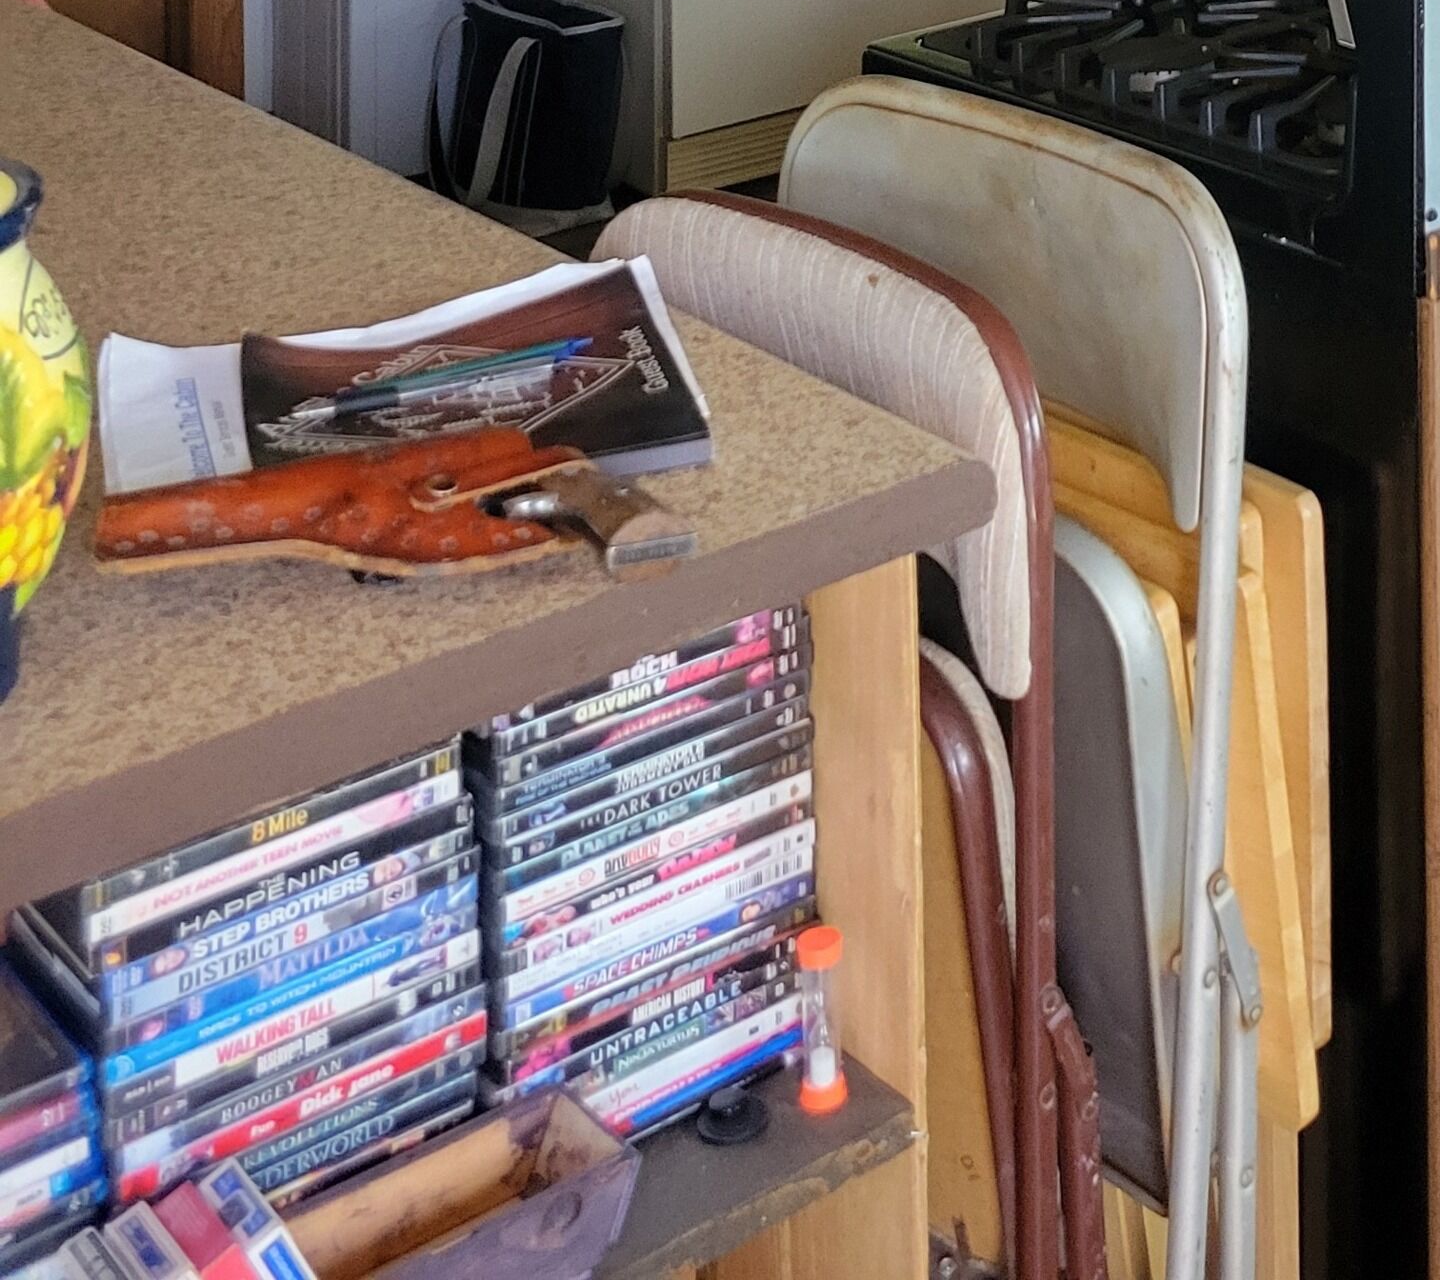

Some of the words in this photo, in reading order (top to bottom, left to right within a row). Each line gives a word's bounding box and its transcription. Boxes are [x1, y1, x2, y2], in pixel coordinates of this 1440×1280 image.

[618, 325, 652, 360] Book
[640, 355, 669, 394] Guest
[573, 682, 653, 724] UNRATED
[251, 821, 266, 843] 8
[267, 807, 309, 838] Mile
[603, 792, 651, 825] DARK
[658, 763, 723, 802] TOWER
[152, 882, 194, 909] NOT
[194, 859, 259, 893] ANOTHER
[261, 842, 299, 868] TEEN
[178, 850, 362, 939] HAPPENING
[609, 890, 674, 926] WEDDING
[676, 861, 741, 897] CRASHERS
[191, 922, 248, 958] STEP
[254, 871, 371, 931] BROTHERS
[177, 930, 288, 996] DISTRICT
[291, 921, 310, 945] 9
[256, 924, 371, 990] MATILDA
[573, 959, 630, 994] SPACE
[629, 927, 699, 973] CHIMPS
[216, 1017, 297, 1066] WALKING
[298, 997, 338, 1034] TALL
[590, 981, 742, 1066] UNTRACEABLE
[631, 993, 673, 1025] AMERICAN
[220, 1057, 344, 1126] BOOGEYMAN
[300, 1085, 346, 1115] Dick
[242, 1098, 380, 1170] REVOLUTIONS
